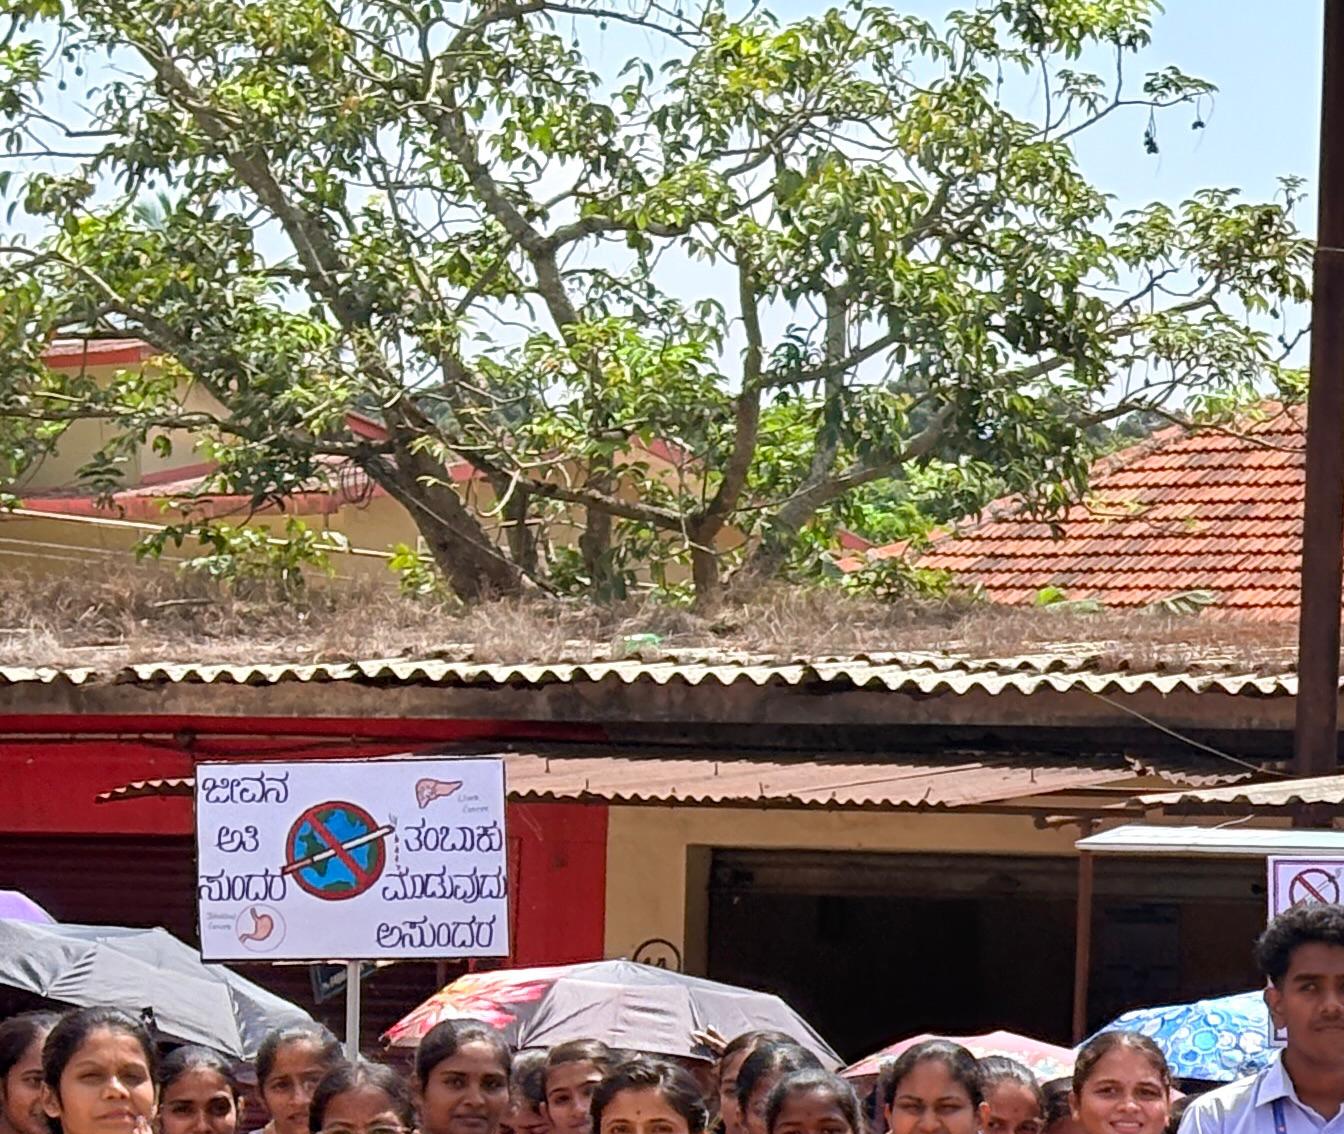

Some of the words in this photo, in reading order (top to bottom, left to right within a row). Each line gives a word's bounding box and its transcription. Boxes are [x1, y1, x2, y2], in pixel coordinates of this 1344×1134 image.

[201, 771, 289, 804] ಜೀವನ
[217, 825, 260, 852] ಅತಿ
[404, 817, 503, 852] ತಂಬಾಕು
[199, 867, 287, 902] ಸುಂದರ
[375, 914, 497, 949] ಅಸುಂದರ
